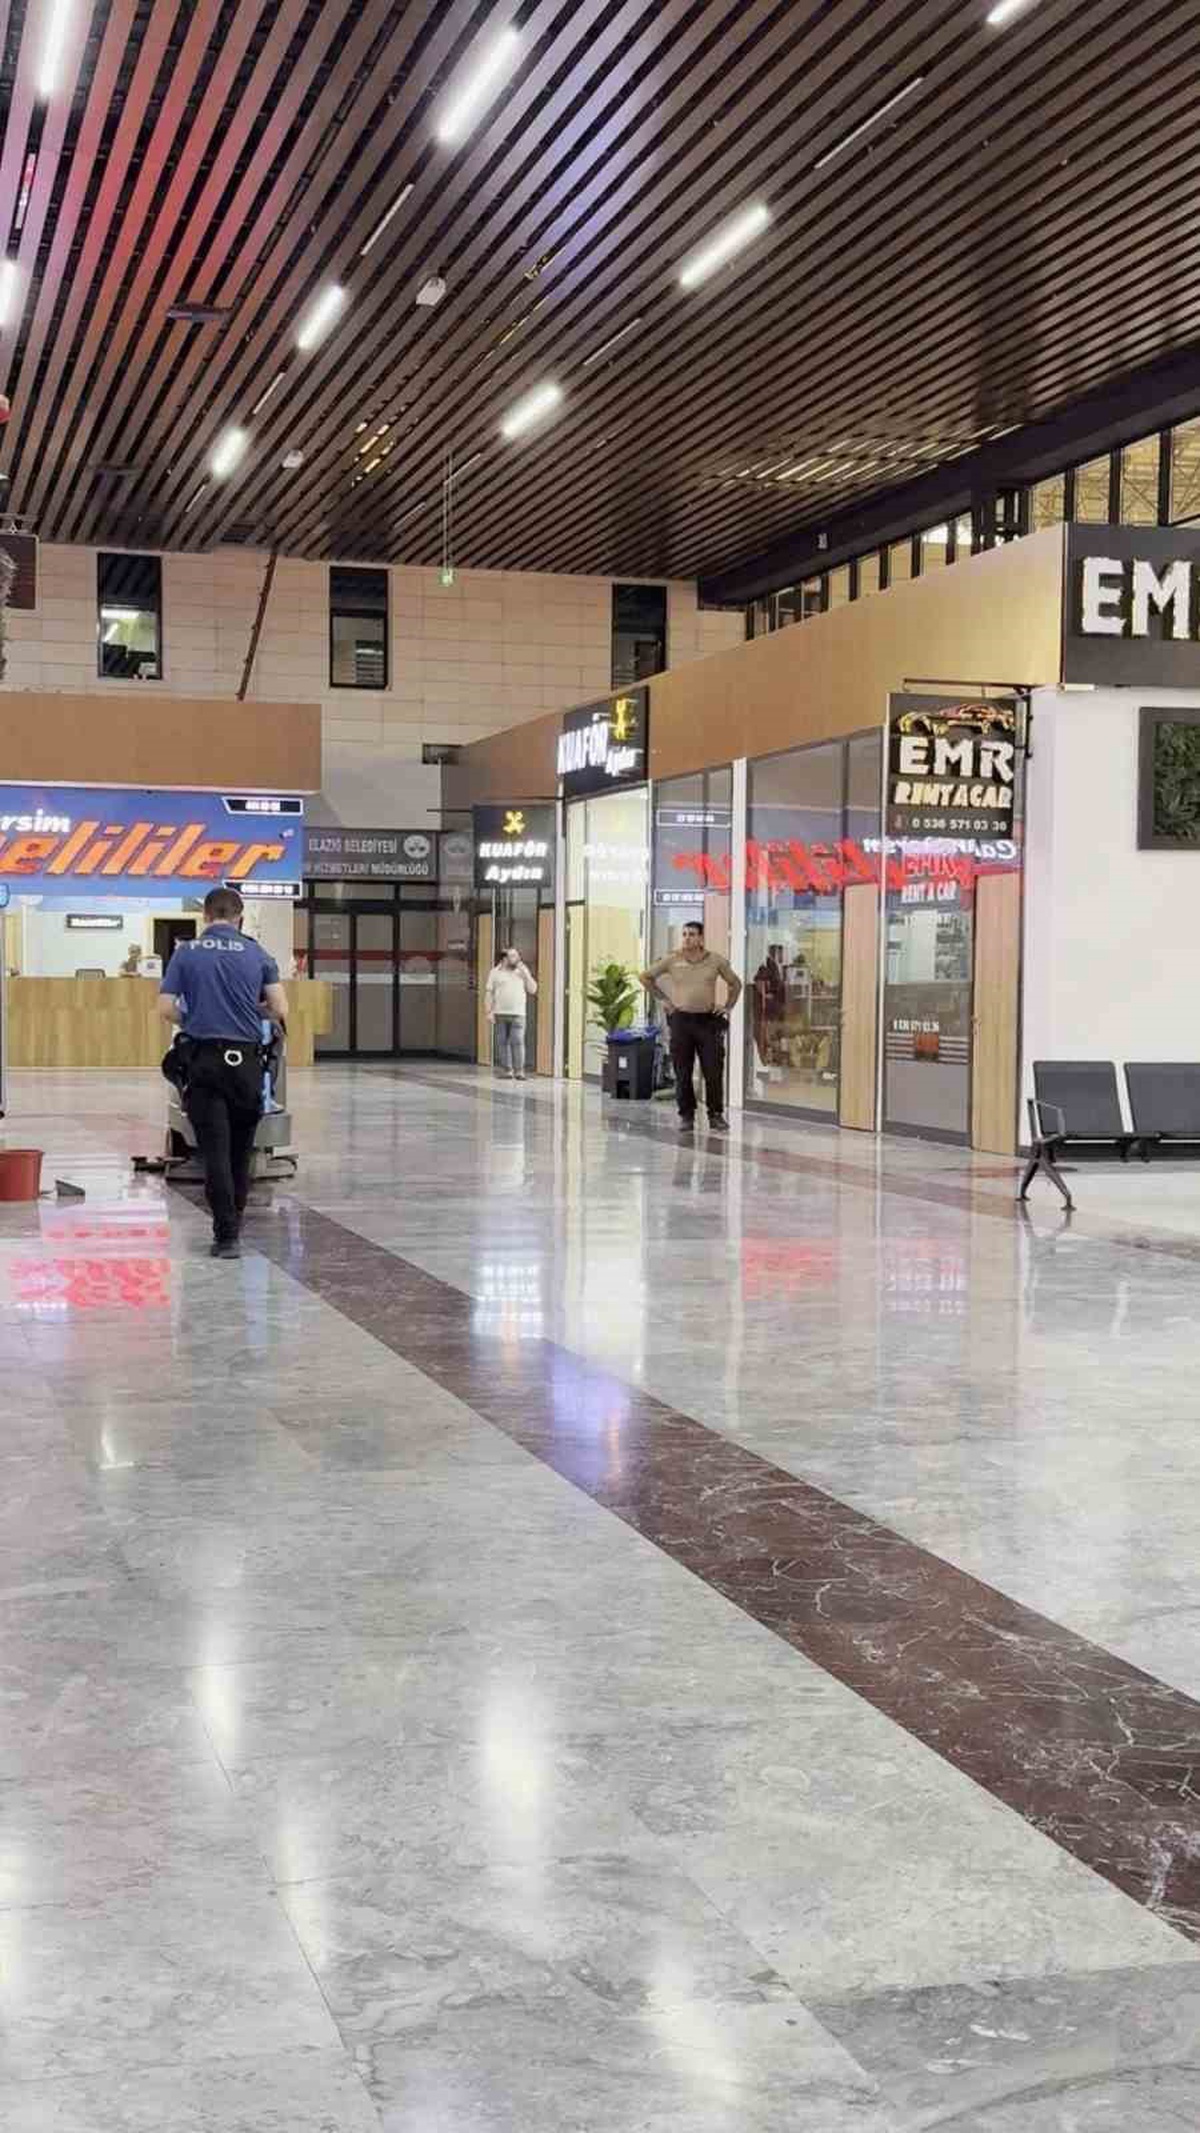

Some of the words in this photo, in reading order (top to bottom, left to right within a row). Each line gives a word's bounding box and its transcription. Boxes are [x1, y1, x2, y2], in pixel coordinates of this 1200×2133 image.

[1082, 556, 1200, 640] EM
[899, 736, 1014, 782] EMR
[0, 820, 286, 878] elililer
[479, 840, 548, 859] KUAFÖR
